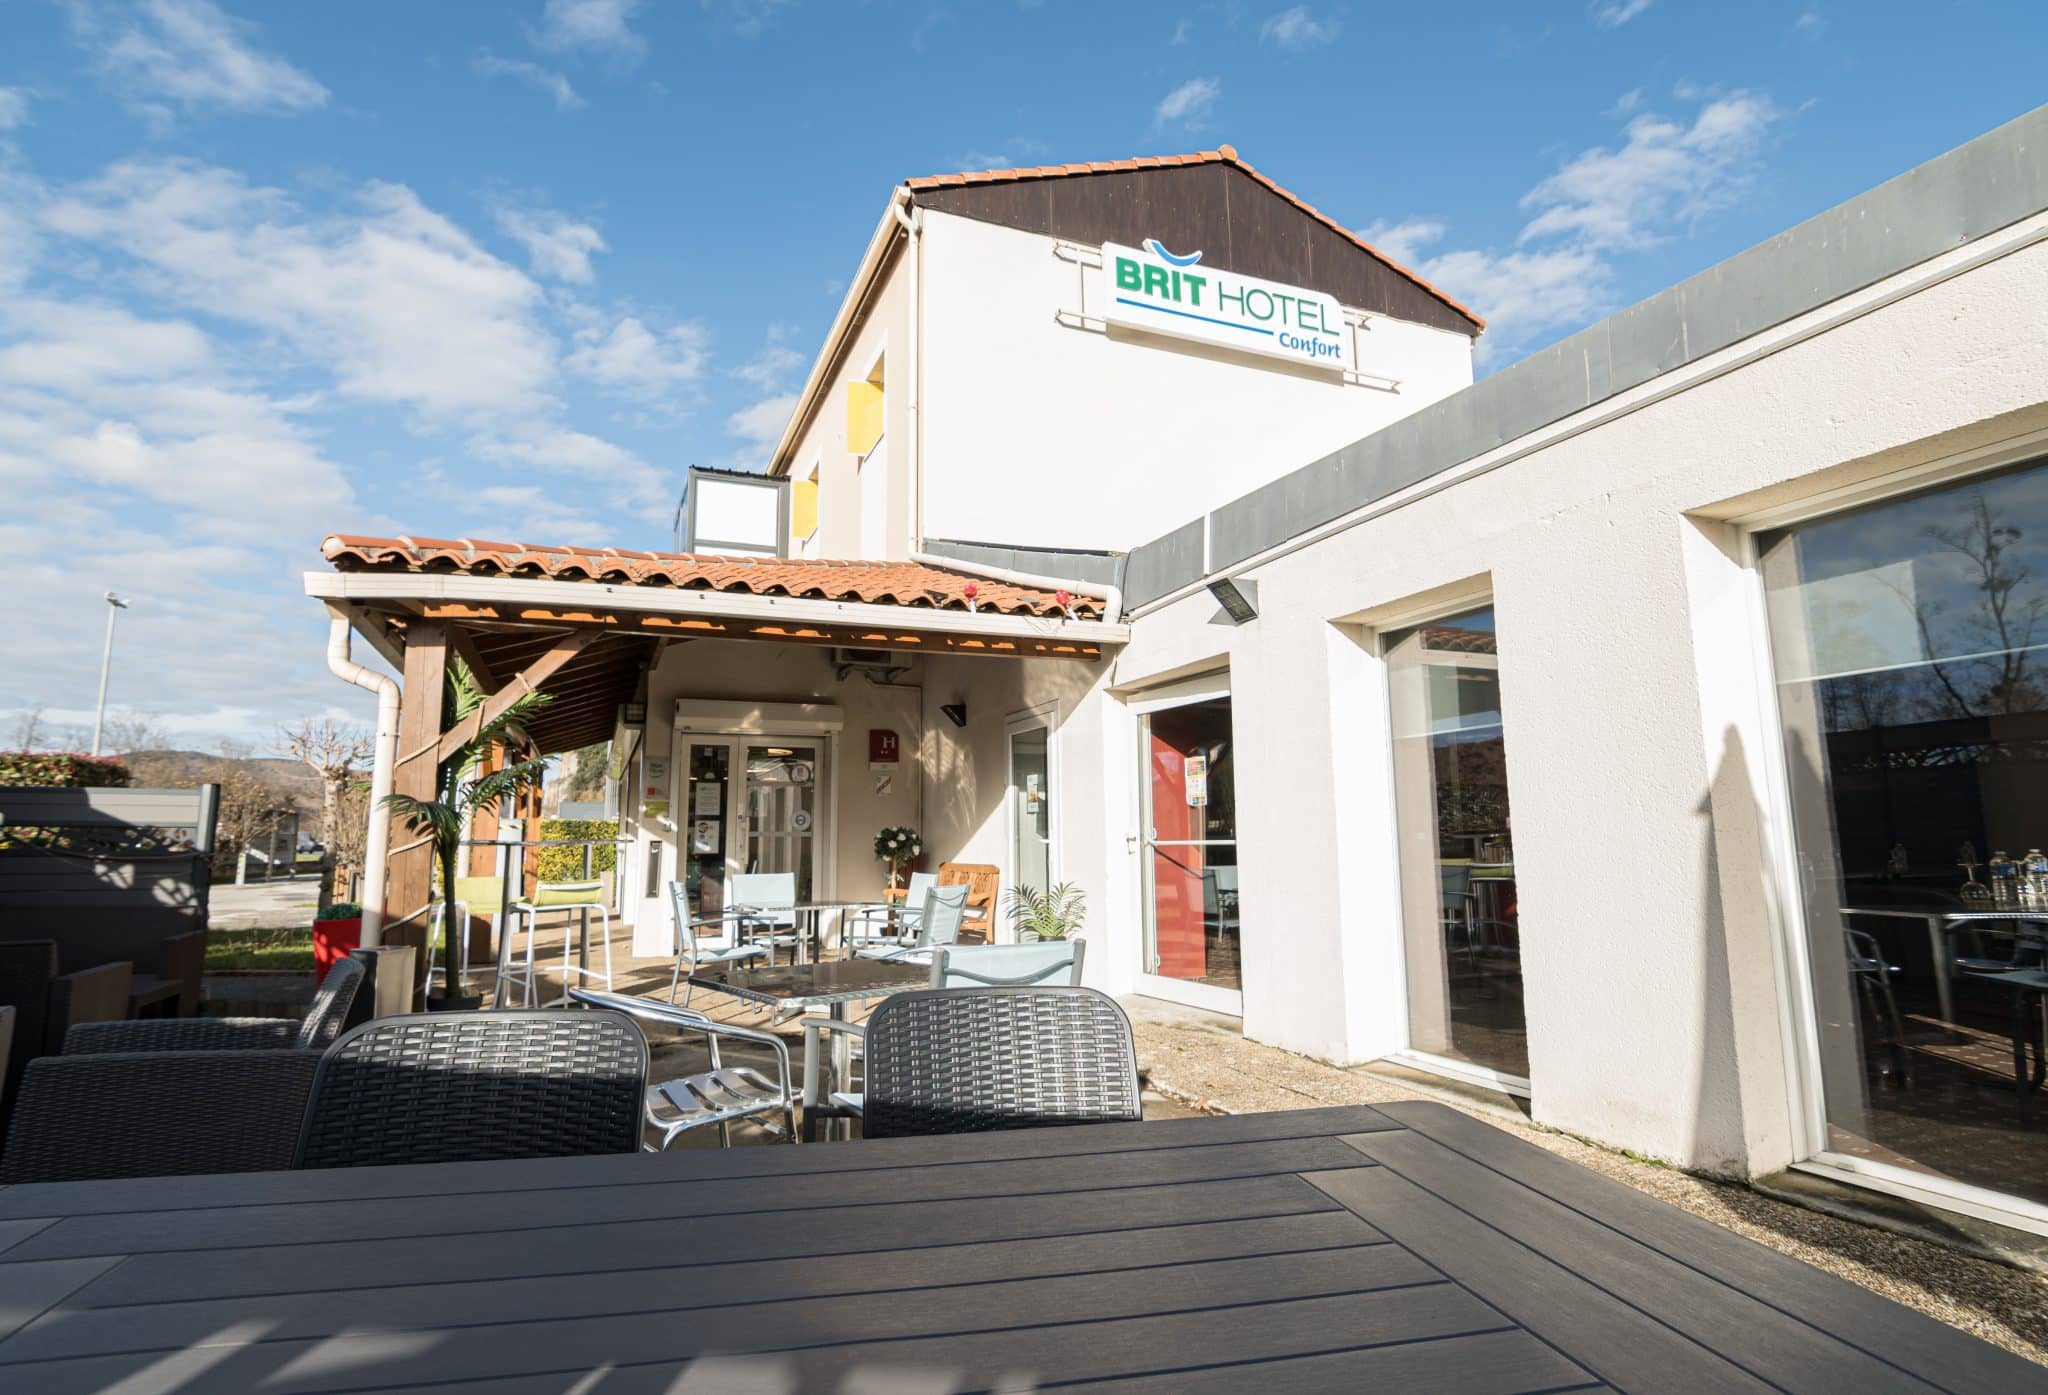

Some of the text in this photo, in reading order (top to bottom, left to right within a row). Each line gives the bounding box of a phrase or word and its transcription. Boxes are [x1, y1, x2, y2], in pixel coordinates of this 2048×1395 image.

[1116, 256, 1340, 336] BRIT HOTEL
[1279, 332, 1341, 358] Confort
[883, 736, 895, 749] H
